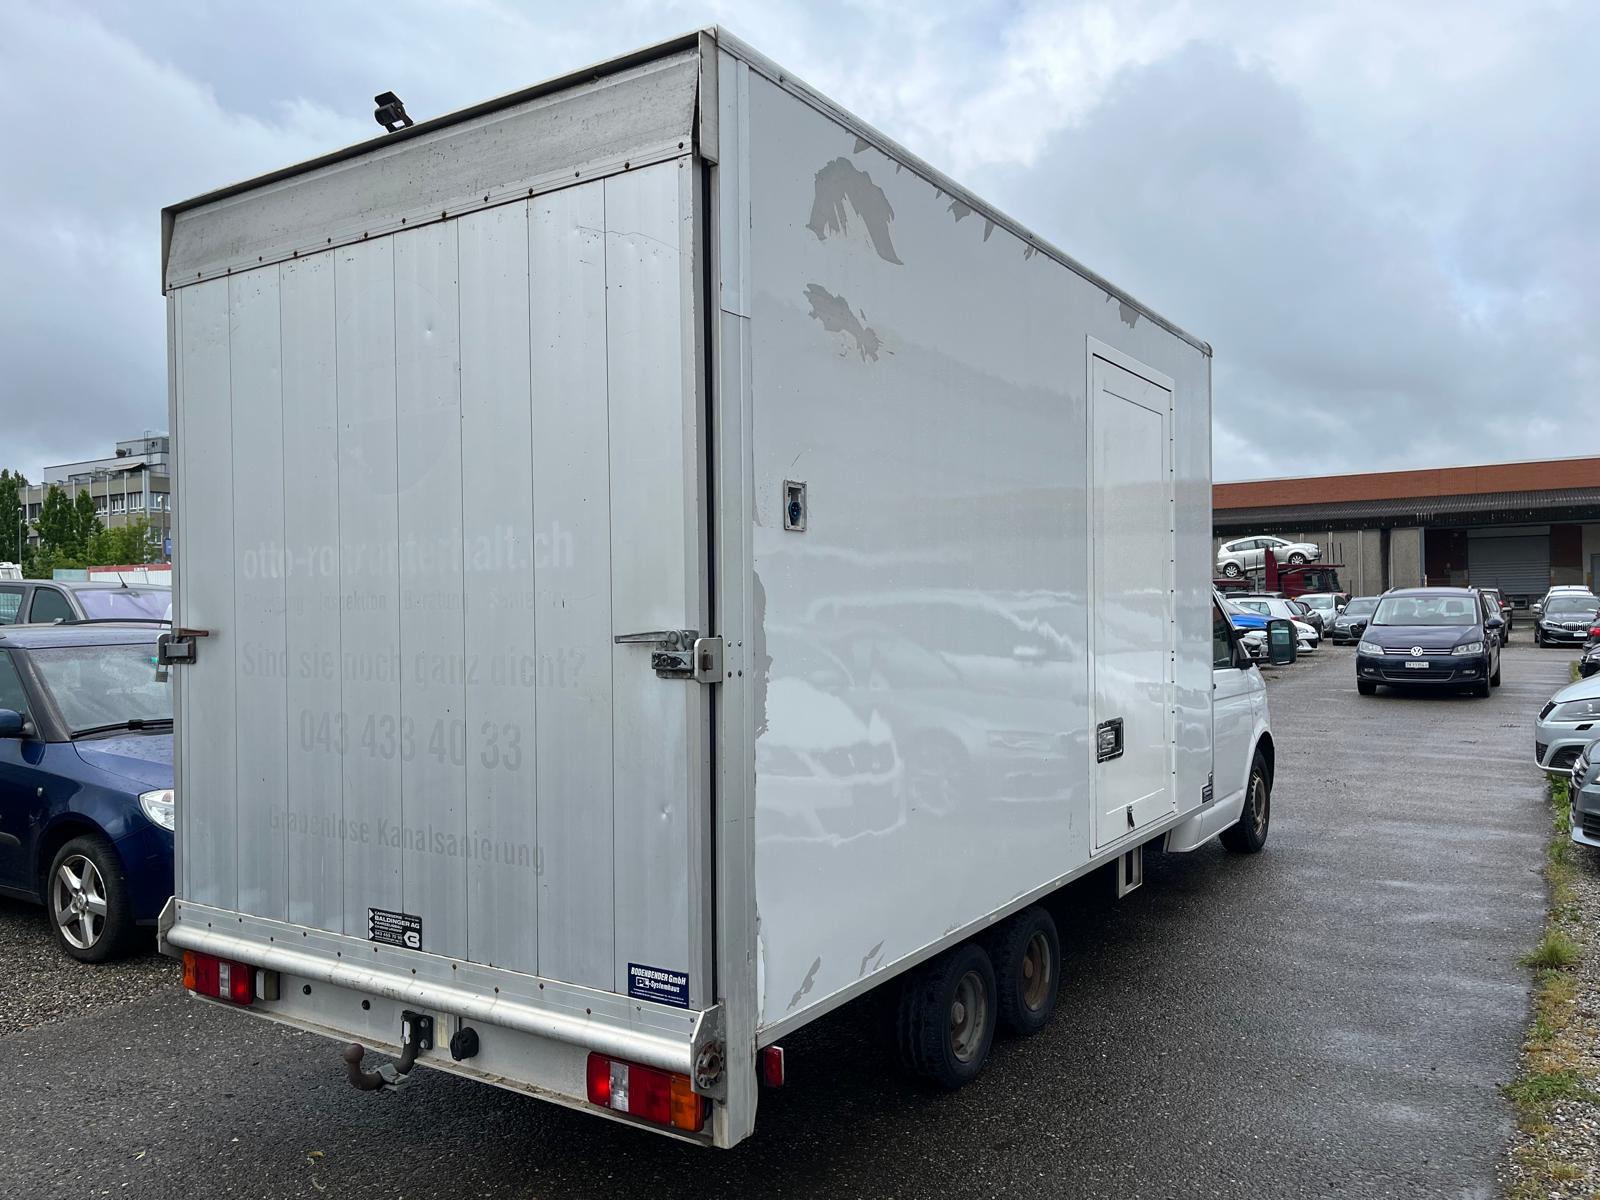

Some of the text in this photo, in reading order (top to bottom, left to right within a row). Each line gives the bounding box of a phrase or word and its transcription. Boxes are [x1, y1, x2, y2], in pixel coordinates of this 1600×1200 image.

[300, 643, 335, 680] sie
[343, 644, 400, 683] noch
[413, 652, 480, 691] ganz
[300, 708, 523, 772] 043 433 40 33
[376, 816, 545, 878] Kanalsanierung
[374, 915, 410, 927] BALDINGER
[631, 967, 686, 986] BODENBENDER GmbH
